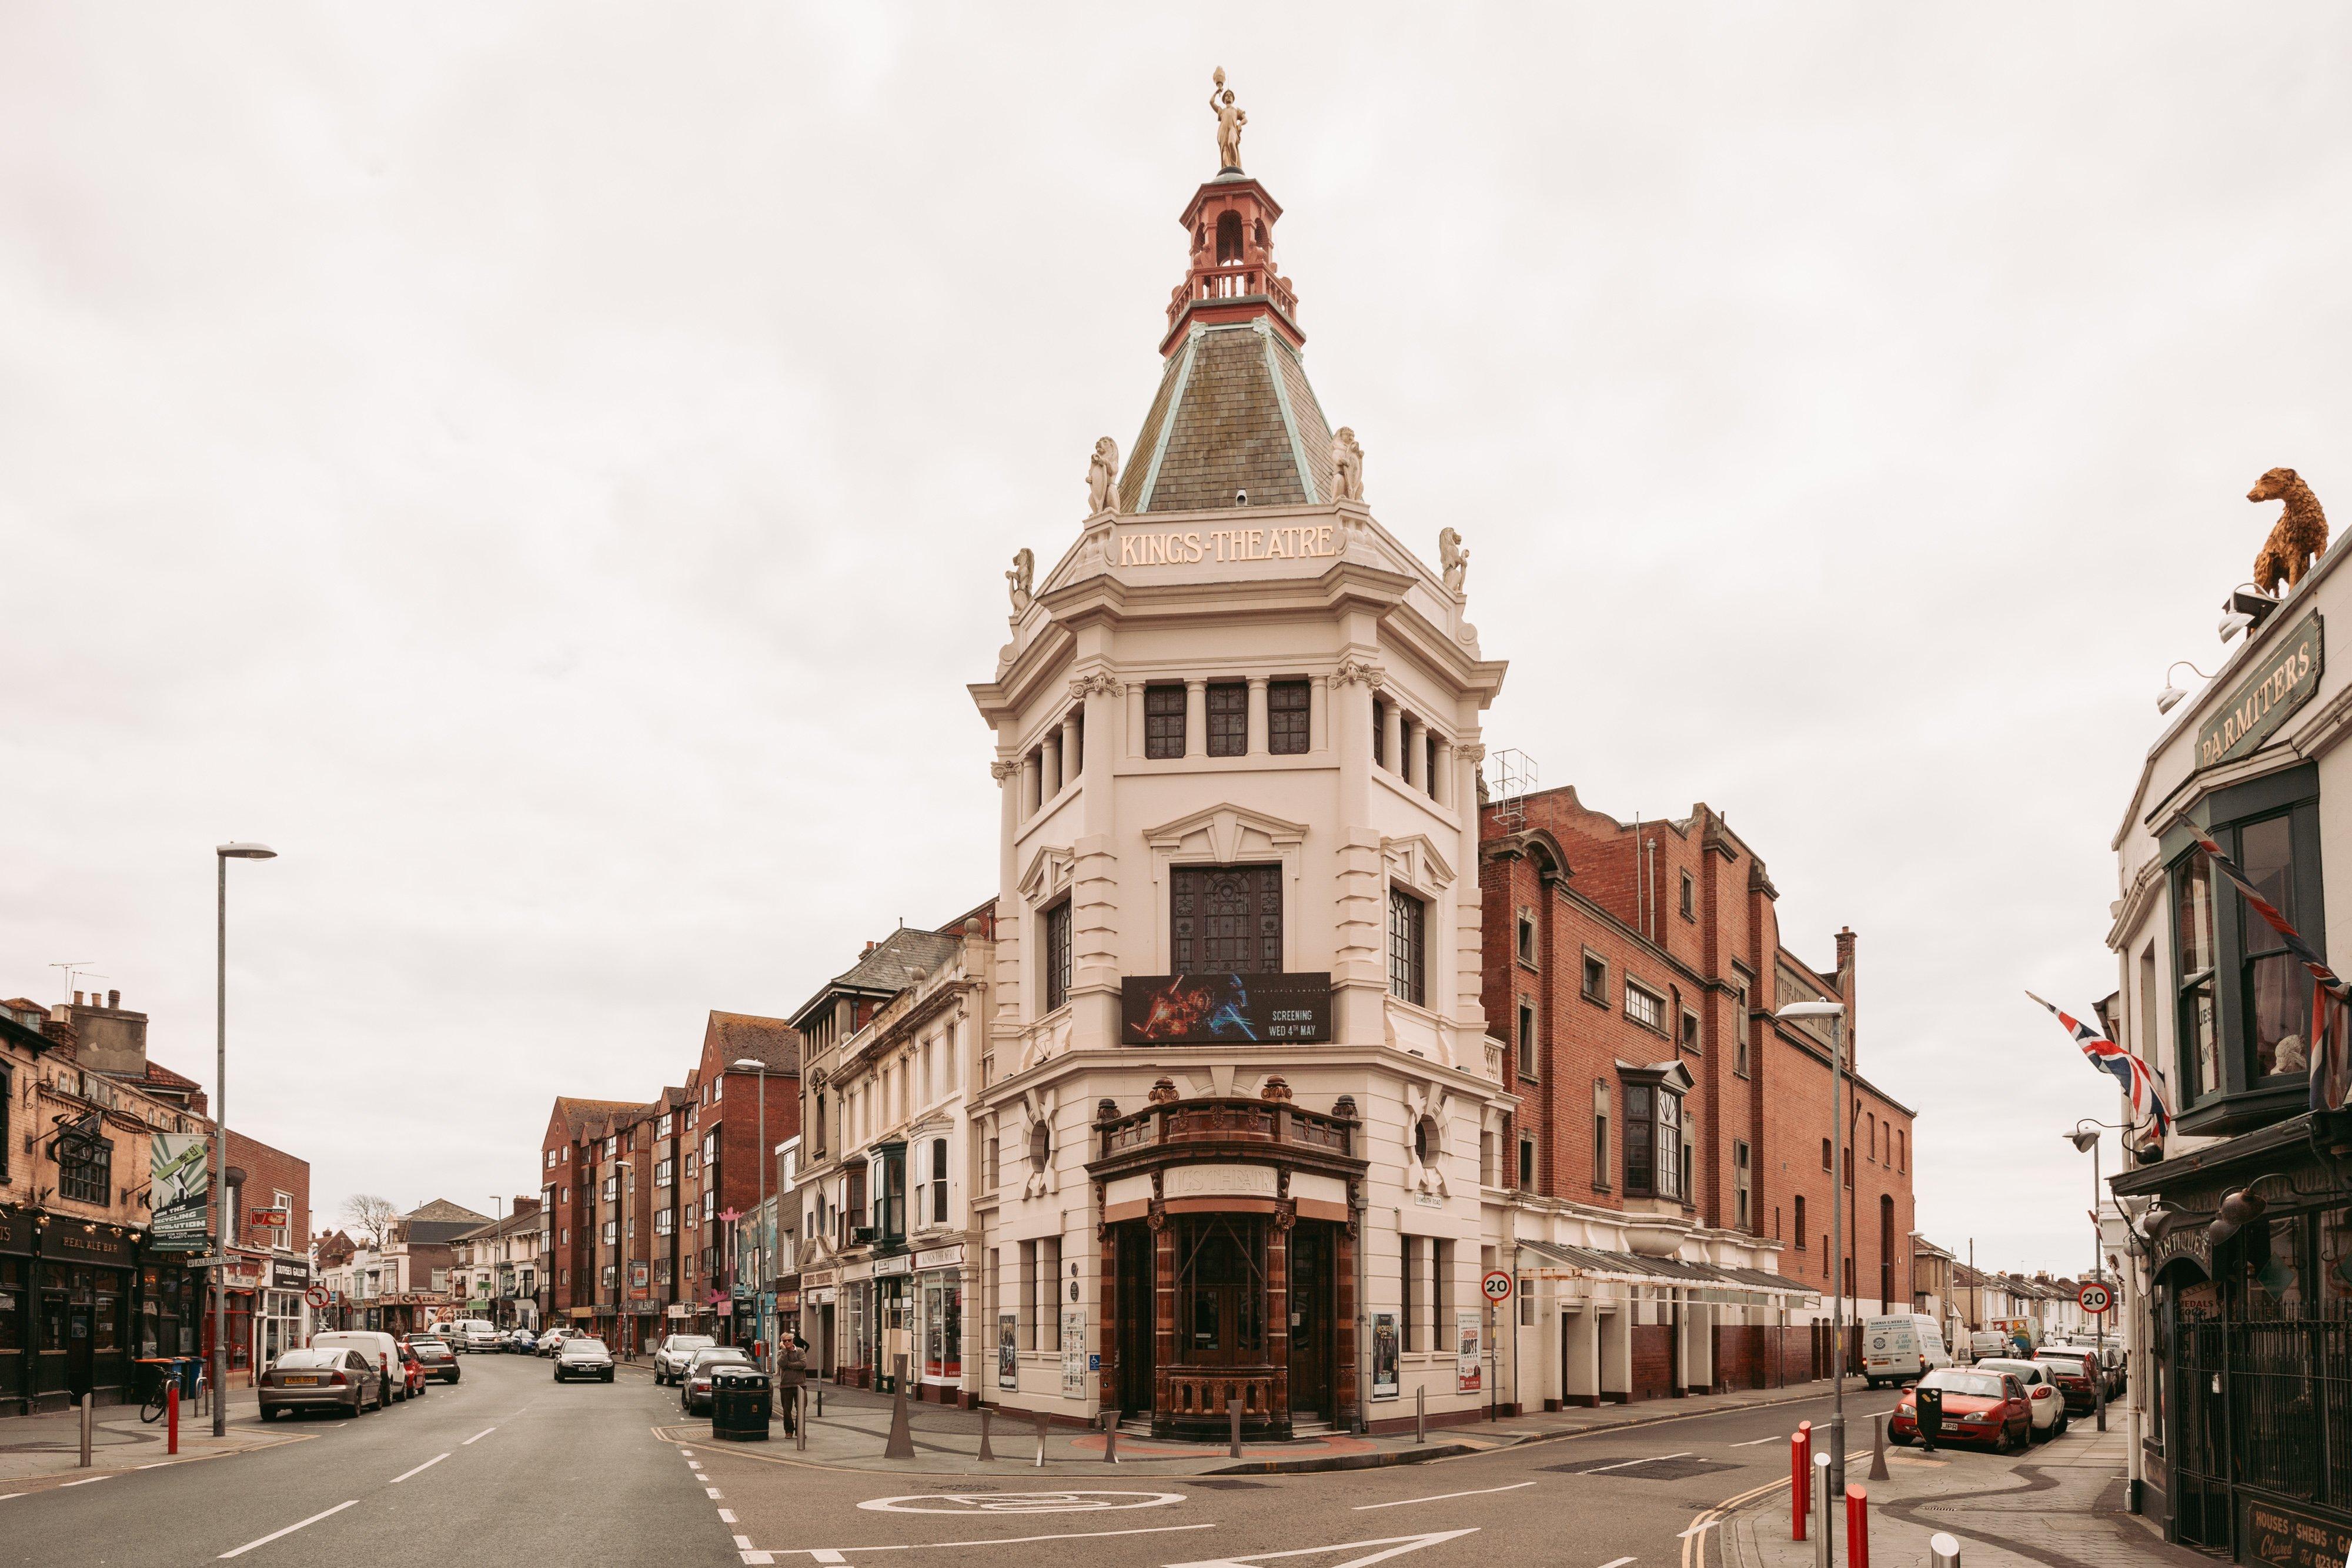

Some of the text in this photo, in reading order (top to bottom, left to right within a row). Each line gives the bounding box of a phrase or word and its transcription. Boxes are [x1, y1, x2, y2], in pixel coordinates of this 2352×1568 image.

[1120, 525, 1335, 566] KINGS THEATRE
[2202, 641, 2310, 767] PARMITERS
[1272, 1010, 1312, 1021] SCREENING
[1269, 1025, 1316, 1036] WED 4TH MAY
[1207, 1169, 1277, 1193] THEATRE
[169, 1205, 186, 1214] THE
[154, 1211, 196, 1224] RECYCLING
[154, 1220, 206, 1230] REVOLUTION
[63, 1237, 118, 1253] REAL ALE BAR
[2159, 1232, 2206, 1264] ANTIQUES
[196, 1255, 240, 1266] ALBERT ROAD
[922, 1249, 956, 1265] KINGS THEATRE
[276, 1265, 306, 1277] SOUTHSEA GALLERY
[1486, 1280, 1508, 1292] 20
[2083, 1292, 2106, 1305] 20
[2255, 1510, 2288, 1534] HOUSES
[2296, 1523, 2327, 1547] SHEDS
[2261, 1534, 2293, 1557] Cleared
[2300, 1549, 2313, 1566] Tel
